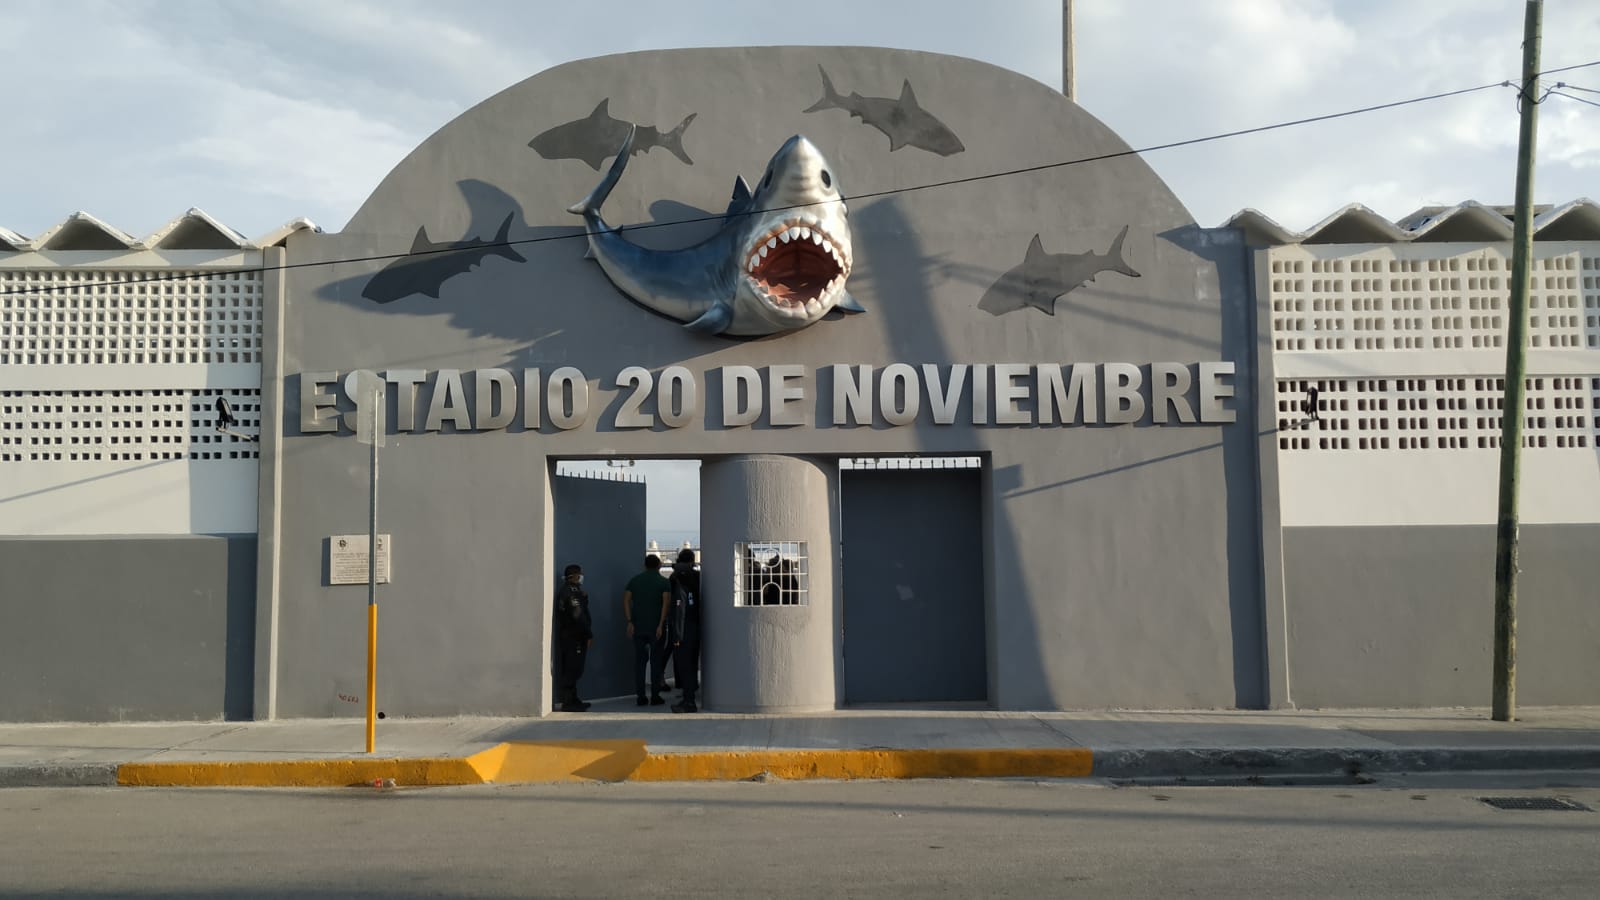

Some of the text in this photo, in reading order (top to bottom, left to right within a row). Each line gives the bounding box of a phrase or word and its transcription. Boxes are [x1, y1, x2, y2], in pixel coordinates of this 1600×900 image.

[614, 366, 696, 429] 20
[722, 364, 806, 427] DE
[832, 362, 1237, 425] NOVIEMBRE
